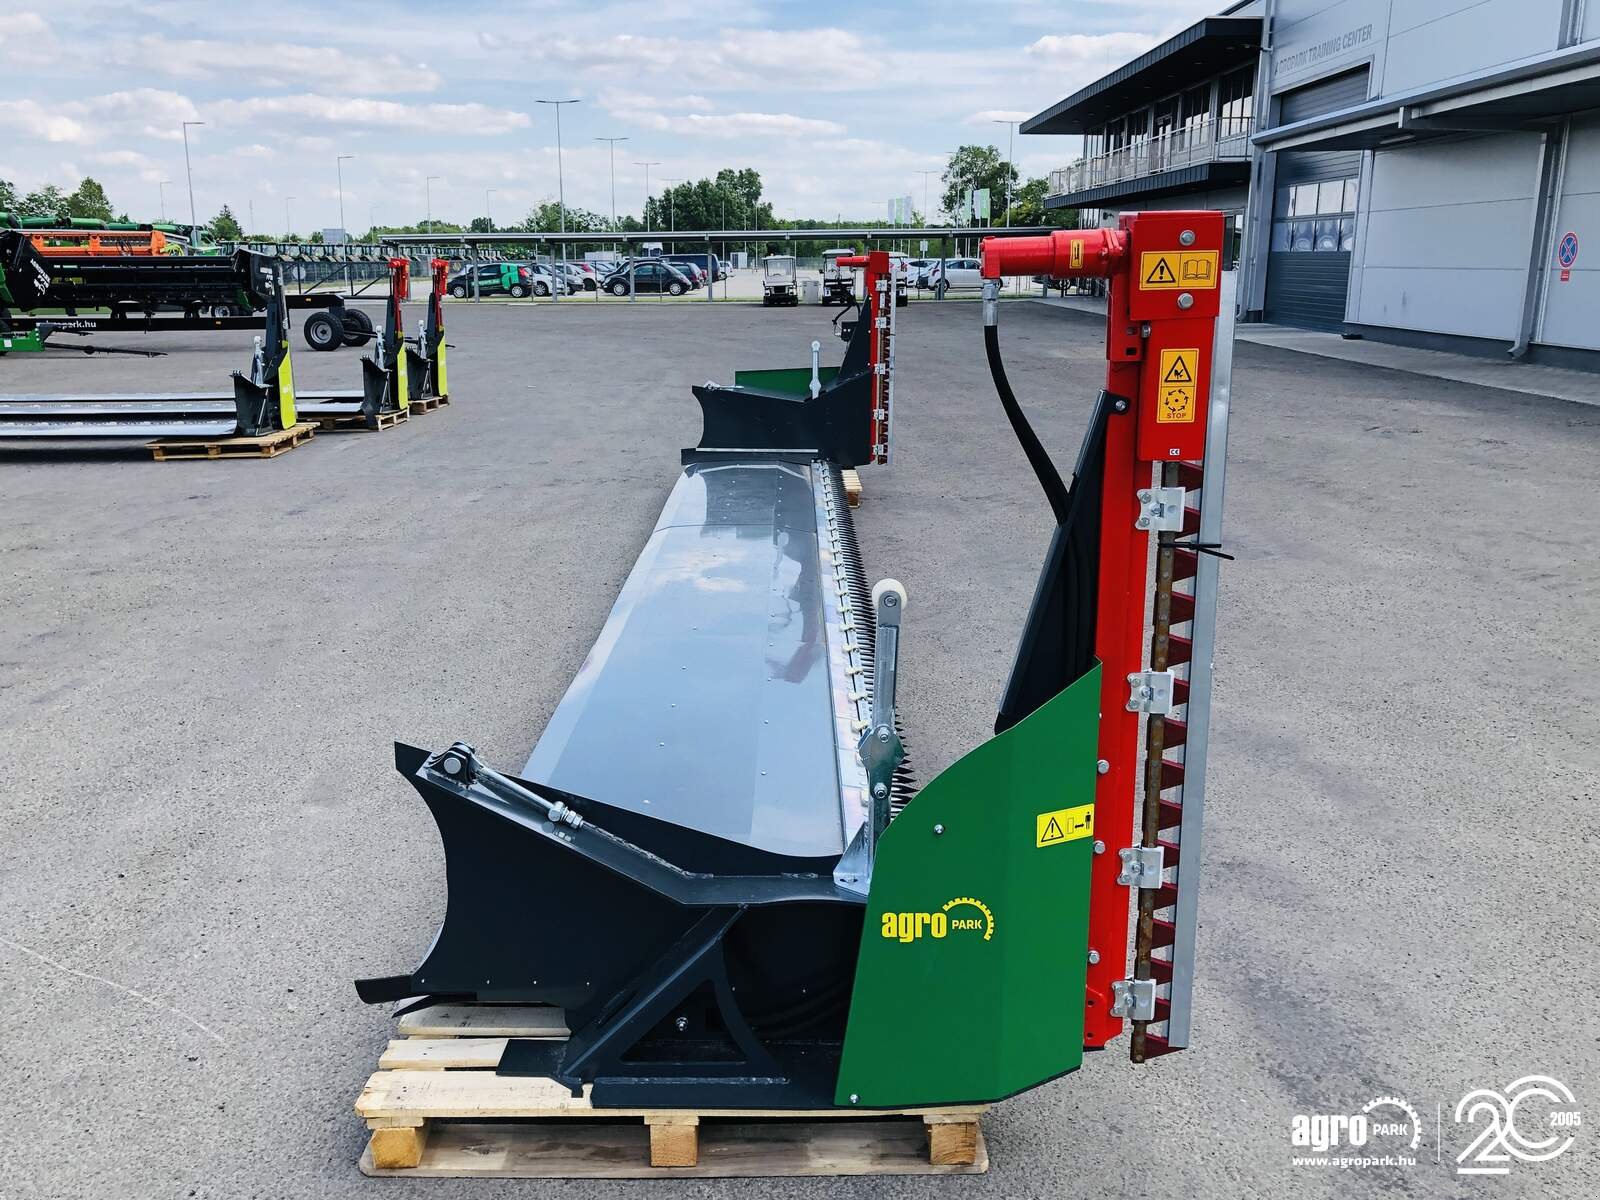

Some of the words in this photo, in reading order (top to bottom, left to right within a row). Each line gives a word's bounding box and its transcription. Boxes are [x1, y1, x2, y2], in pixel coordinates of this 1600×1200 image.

[1309, 37, 1341, 61] TRAINING
[1342, 24, 1373, 49] CENTER
[881, 912, 947, 942] agro
[951, 919, 982, 929] PARK
